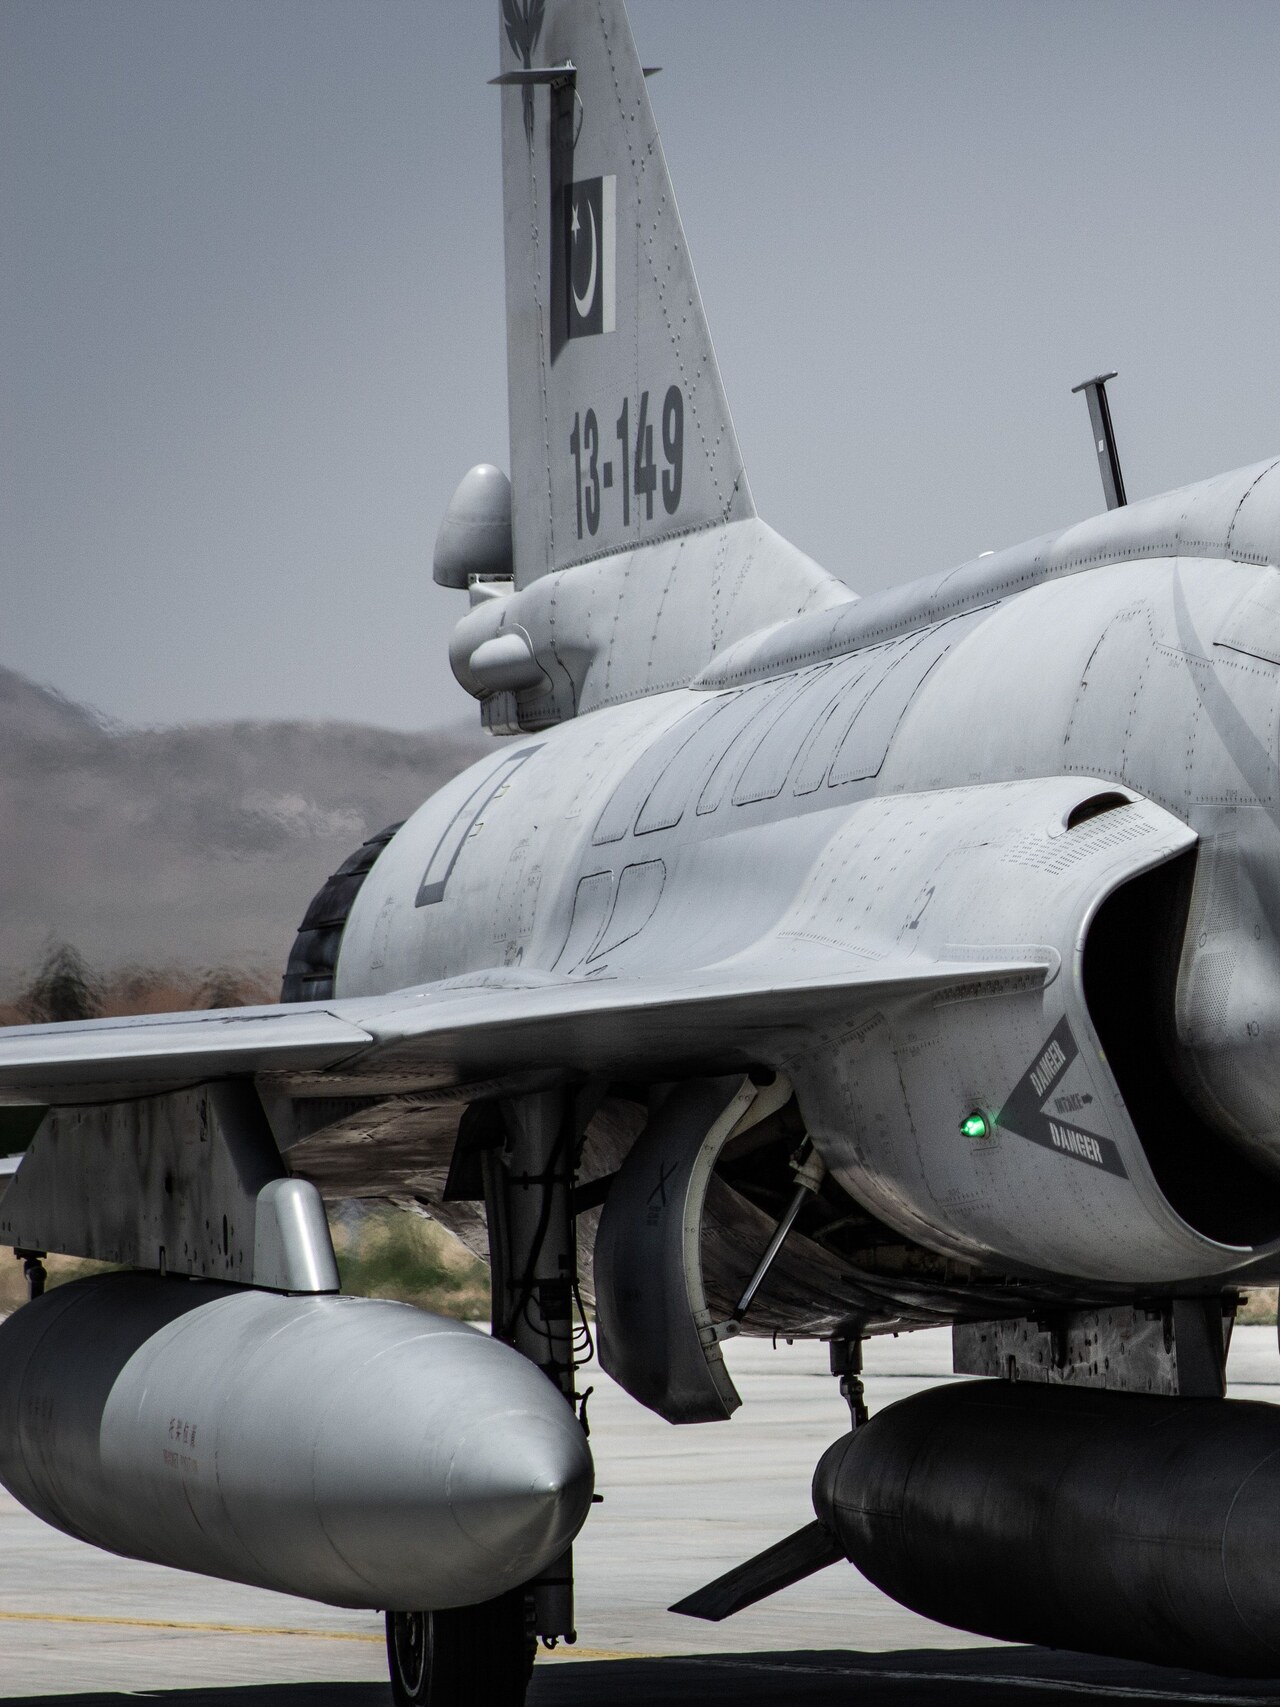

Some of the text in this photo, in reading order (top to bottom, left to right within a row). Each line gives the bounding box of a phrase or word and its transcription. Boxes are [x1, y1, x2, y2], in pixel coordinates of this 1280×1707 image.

[570, 385, 684, 540] 13-149
[1029, 1039, 1067, 1097] DANGER
[1049, 1122, 1103, 1164] DANGER
